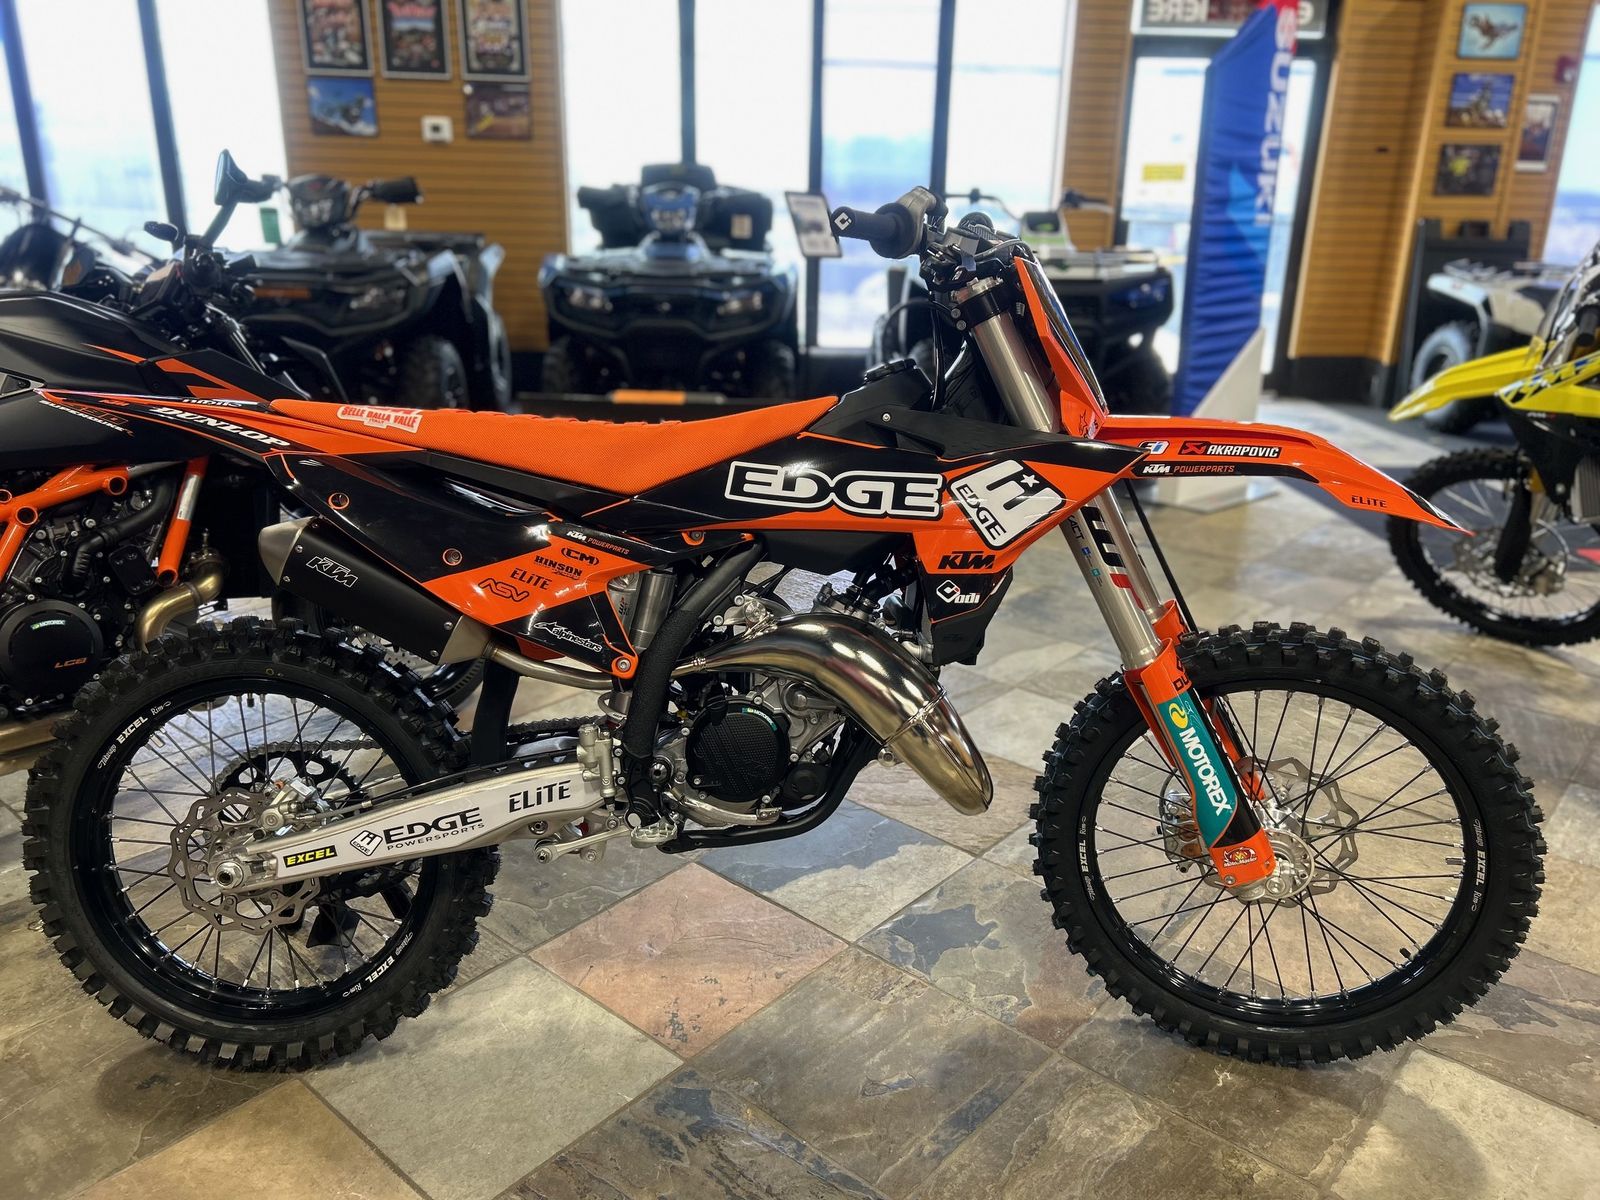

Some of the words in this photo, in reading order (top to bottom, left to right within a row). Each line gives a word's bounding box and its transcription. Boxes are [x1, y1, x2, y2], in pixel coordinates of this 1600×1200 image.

[1254, 7, 1297, 226] SUZUKI
[150, 406, 290, 446] DUNLOP
[342, 405, 365, 417] SELLE
[393, 414, 418, 428] VALLE
[1143, 463, 1171, 473] KTM
[1173, 465, 1235, 473] POWERPARTS
[724, 461, 943, 517] EDGE
[959, 483, 1006, 541] EDGE
[566, 530, 587, 541] KTM
[587, 537, 630, 555] POWERPARTS
[305, 556, 359, 588] KTM
[533, 555, 583, 577] HINSON
[937, 551, 996, 569] KTM
[478, 577, 530, 603] ASV
[954, 592, 981, 604] odi
[552, 626, 603, 653] alpinestars
[116, 716, 148, 744] EXCEL
[150, 702, 169, 716] Rim
[1179, 726, 1233, 817] MOTOREX
[383, 807, 482, 845] EDGE
[387, 823, 485, 851] POWERSPORTS
[285, 847, 336, 867] EXCEL
[352, 840, 371, 854] EDGE
[1079, 840, 1089, 873] EXCEL
[1476, 850, 1486, 886] EXCEL
[365, 955, 396, 983] EXCEL
